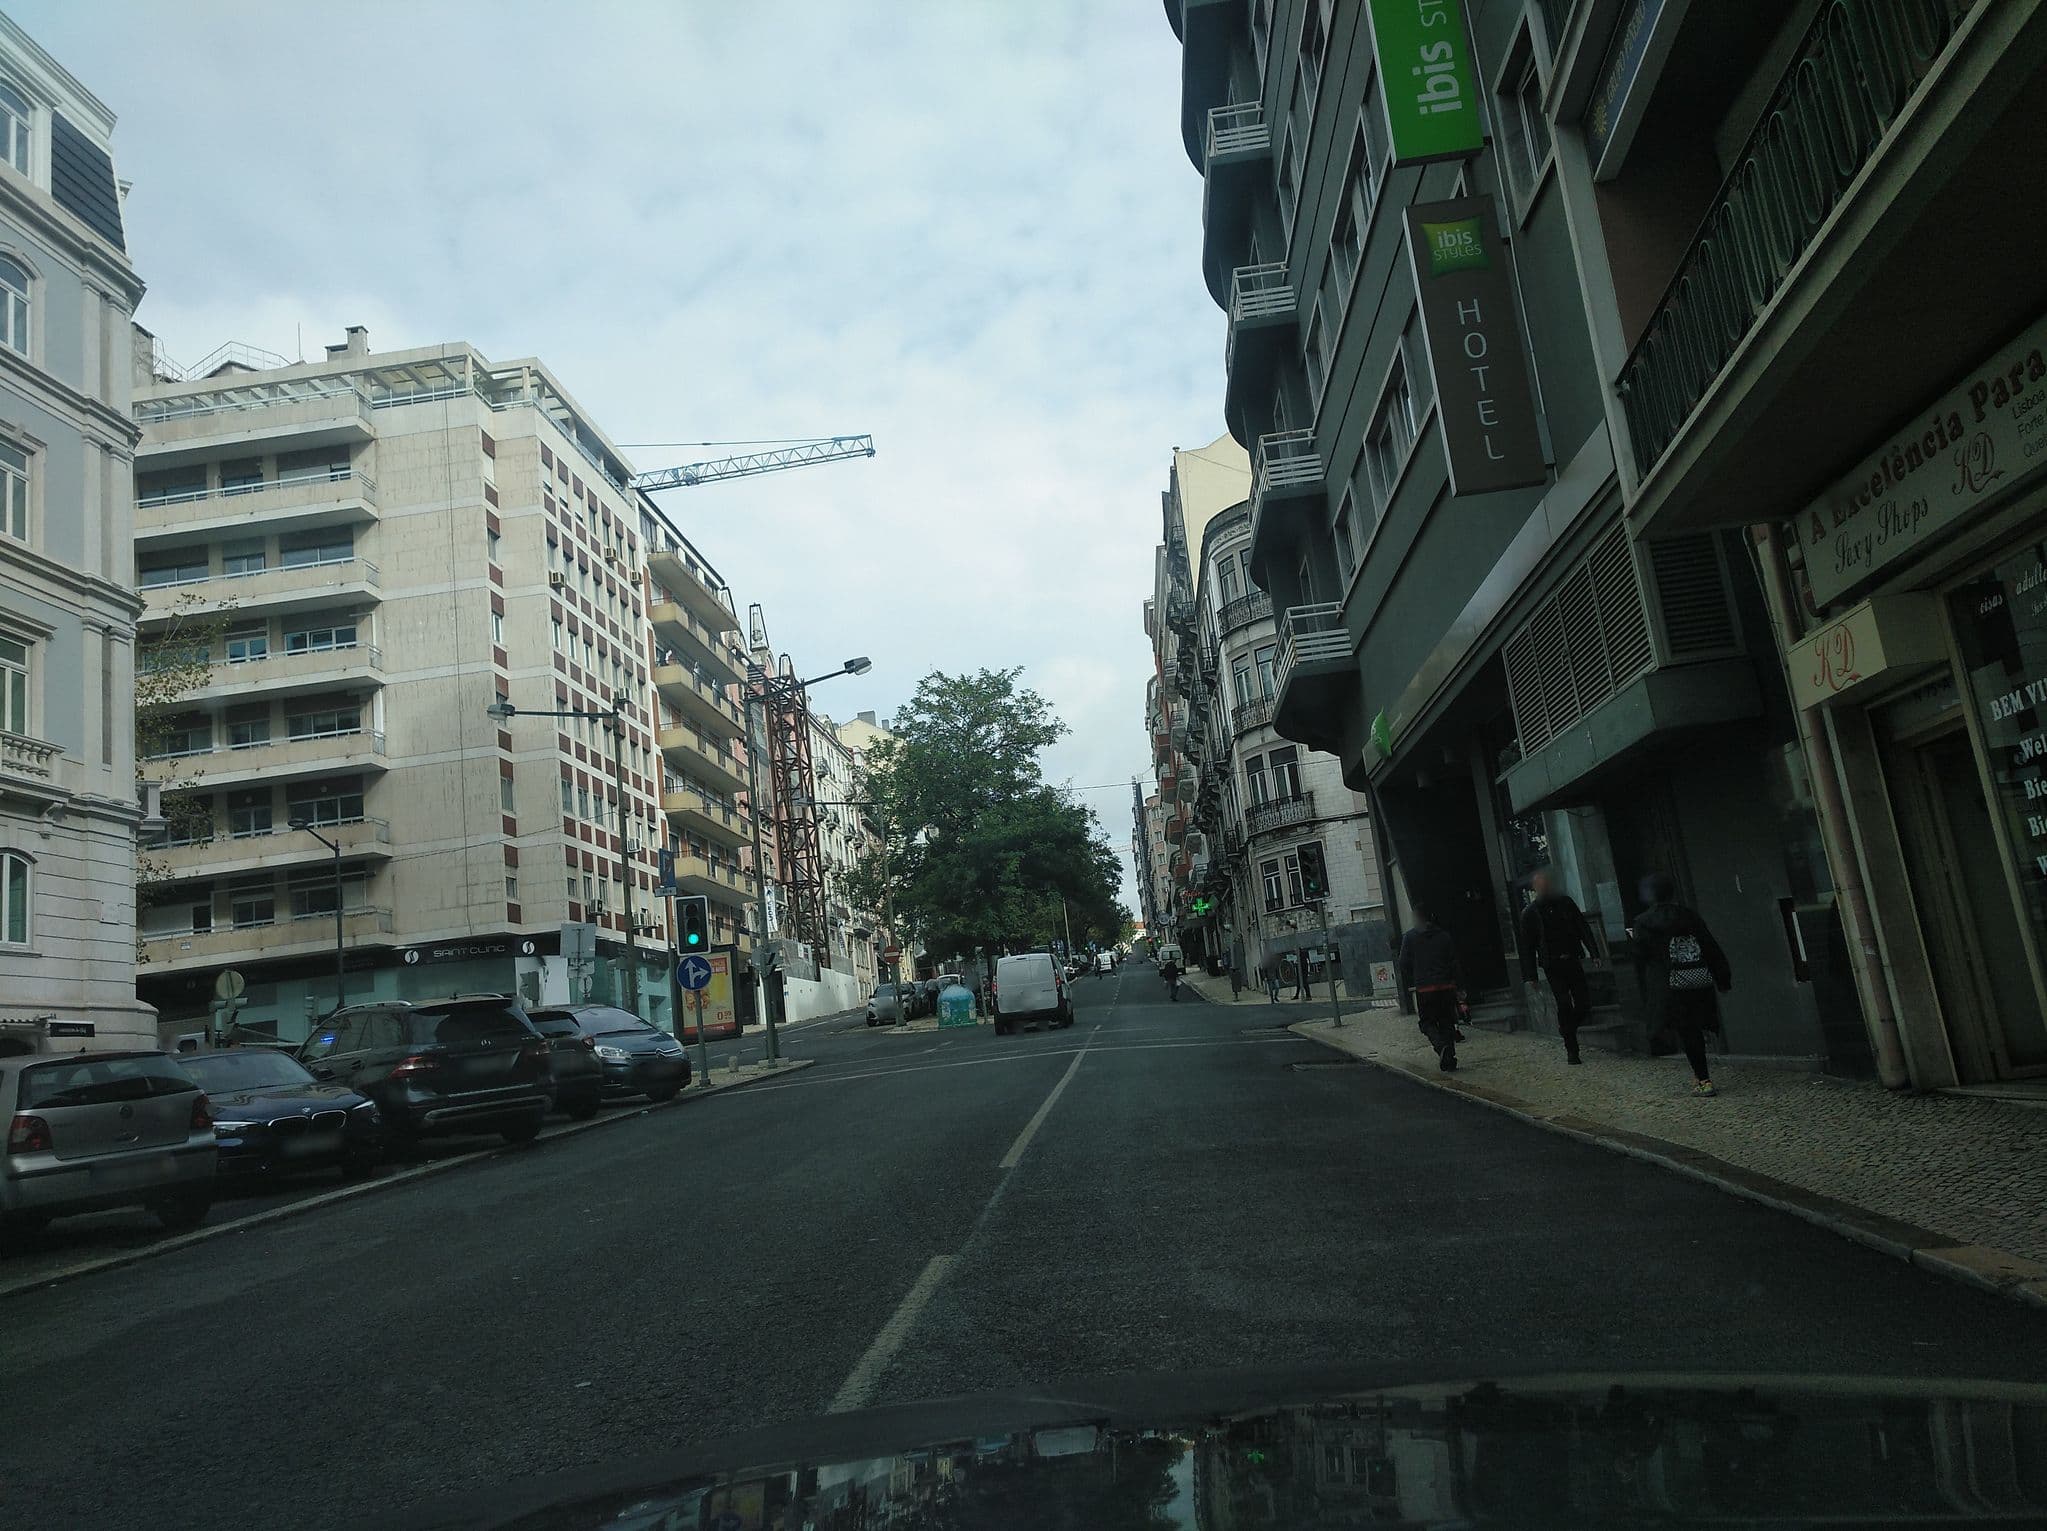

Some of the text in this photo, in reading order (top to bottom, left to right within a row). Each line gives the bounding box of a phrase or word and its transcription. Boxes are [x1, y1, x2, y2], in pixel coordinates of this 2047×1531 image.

[1412, 41, 1463, 114] ibis
[1437, 228, 1473, 249] ibis
[1457, 299, 1505, 460] HOTEL
[1811, 510, 1827, 546] A
[1835, 498, 1929, 574] Sexy Shops
[1990, 677, 2047, 721] BEM VI
